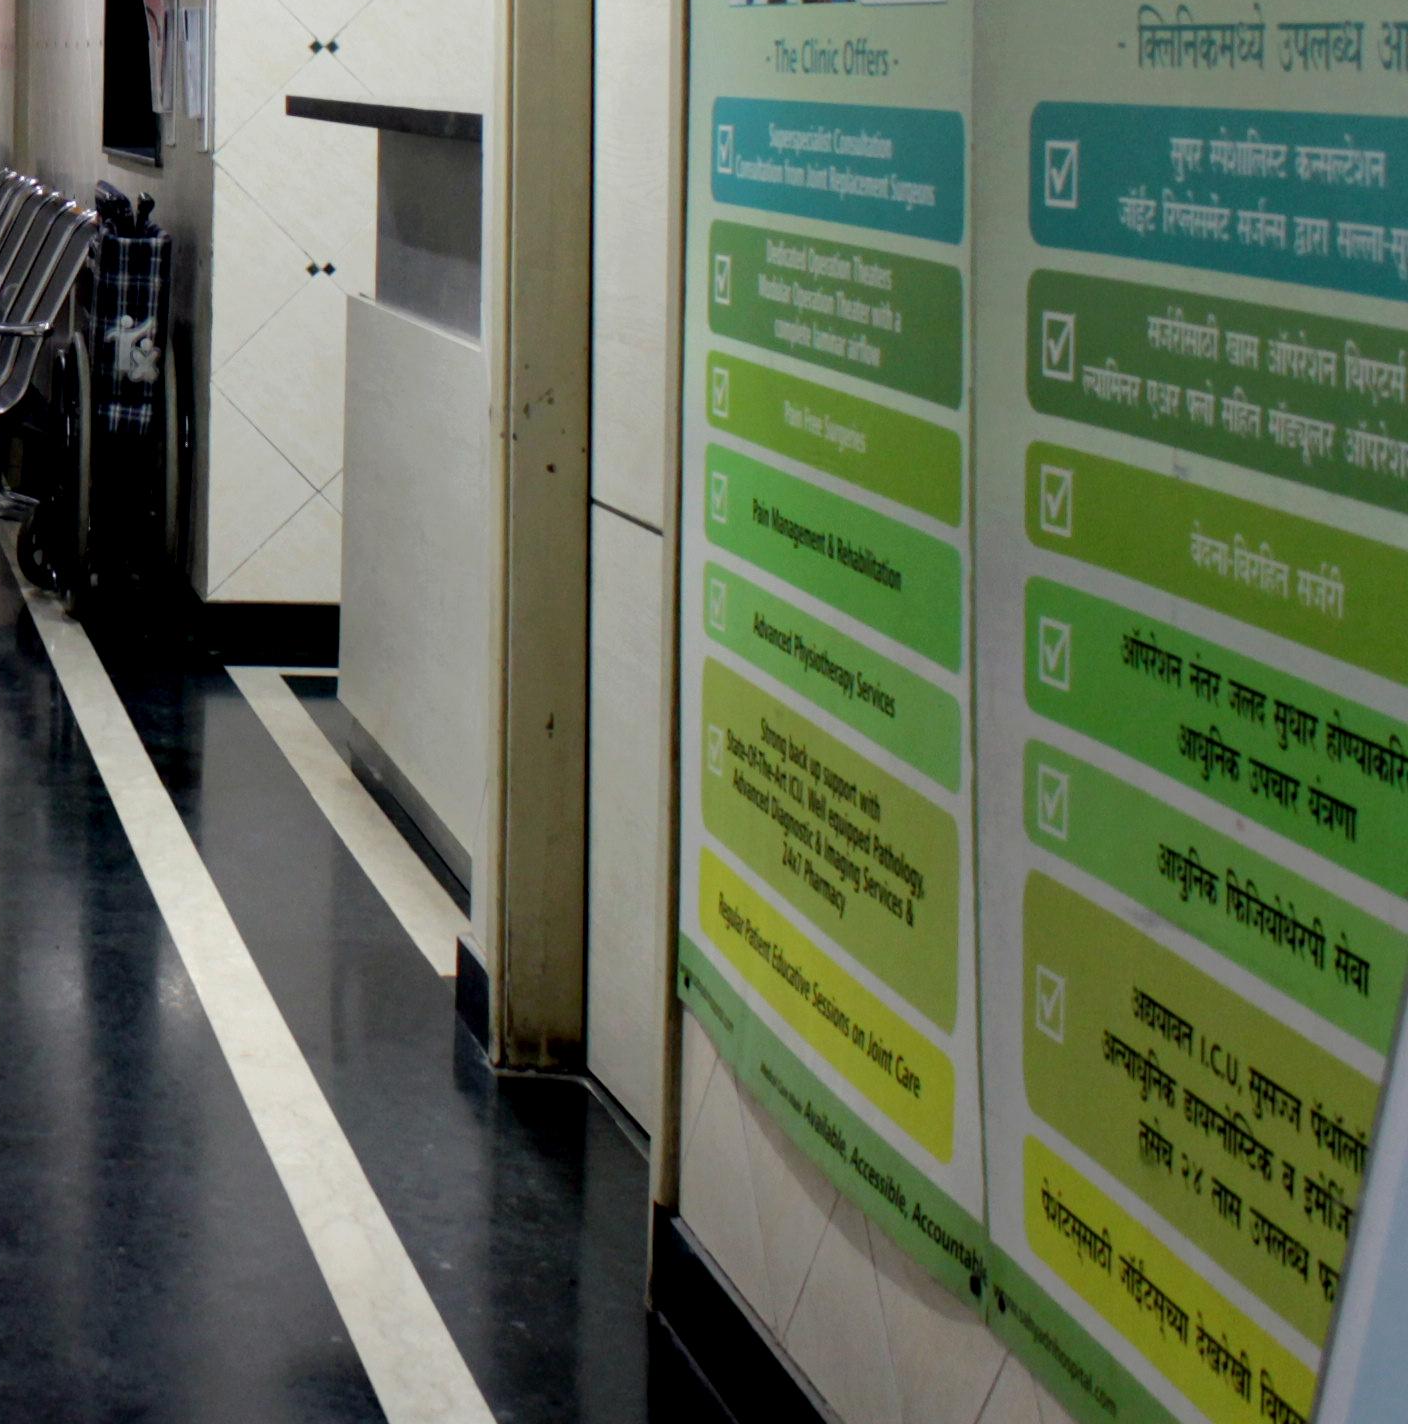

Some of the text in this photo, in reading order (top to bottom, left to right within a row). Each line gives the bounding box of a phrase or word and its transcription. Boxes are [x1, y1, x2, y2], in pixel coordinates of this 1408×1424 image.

[774, 38, 890, 76] The Clinic Offers
[1278, 20, 1365, 72] उपलब्ध
[754, 611, 896, 718] Advanced Physiotherapy Services
[761, 717, 881, 823] Strong back up support with
[1325, 708, 1408, 793] होण्याकरि
[734, 768, 914, 928] Advanced Diagnostic & Imaging Services &
[808, 784, 826, 822] Well
[828, 808, 871, 856] equipped
[804, 858, 846, 920] Pharmacy
[745, 918, 772, 963] Patient
[772, 944, 810, 1001] Educative
[812, 982, 850, 1038] Sessions
[852, 1023, 865, 1050] on
[867, 1031, 893, 1075] Joint
[896, 1054, 922, 1099] Care
[804, 1100, 847, 1163] Available,
[850, 1146, 908, 1219] Accessible,
[1310, 1102, 1369, 1174] पॅथॉलॉ
[1282, 1160, 1296, 1201] व
